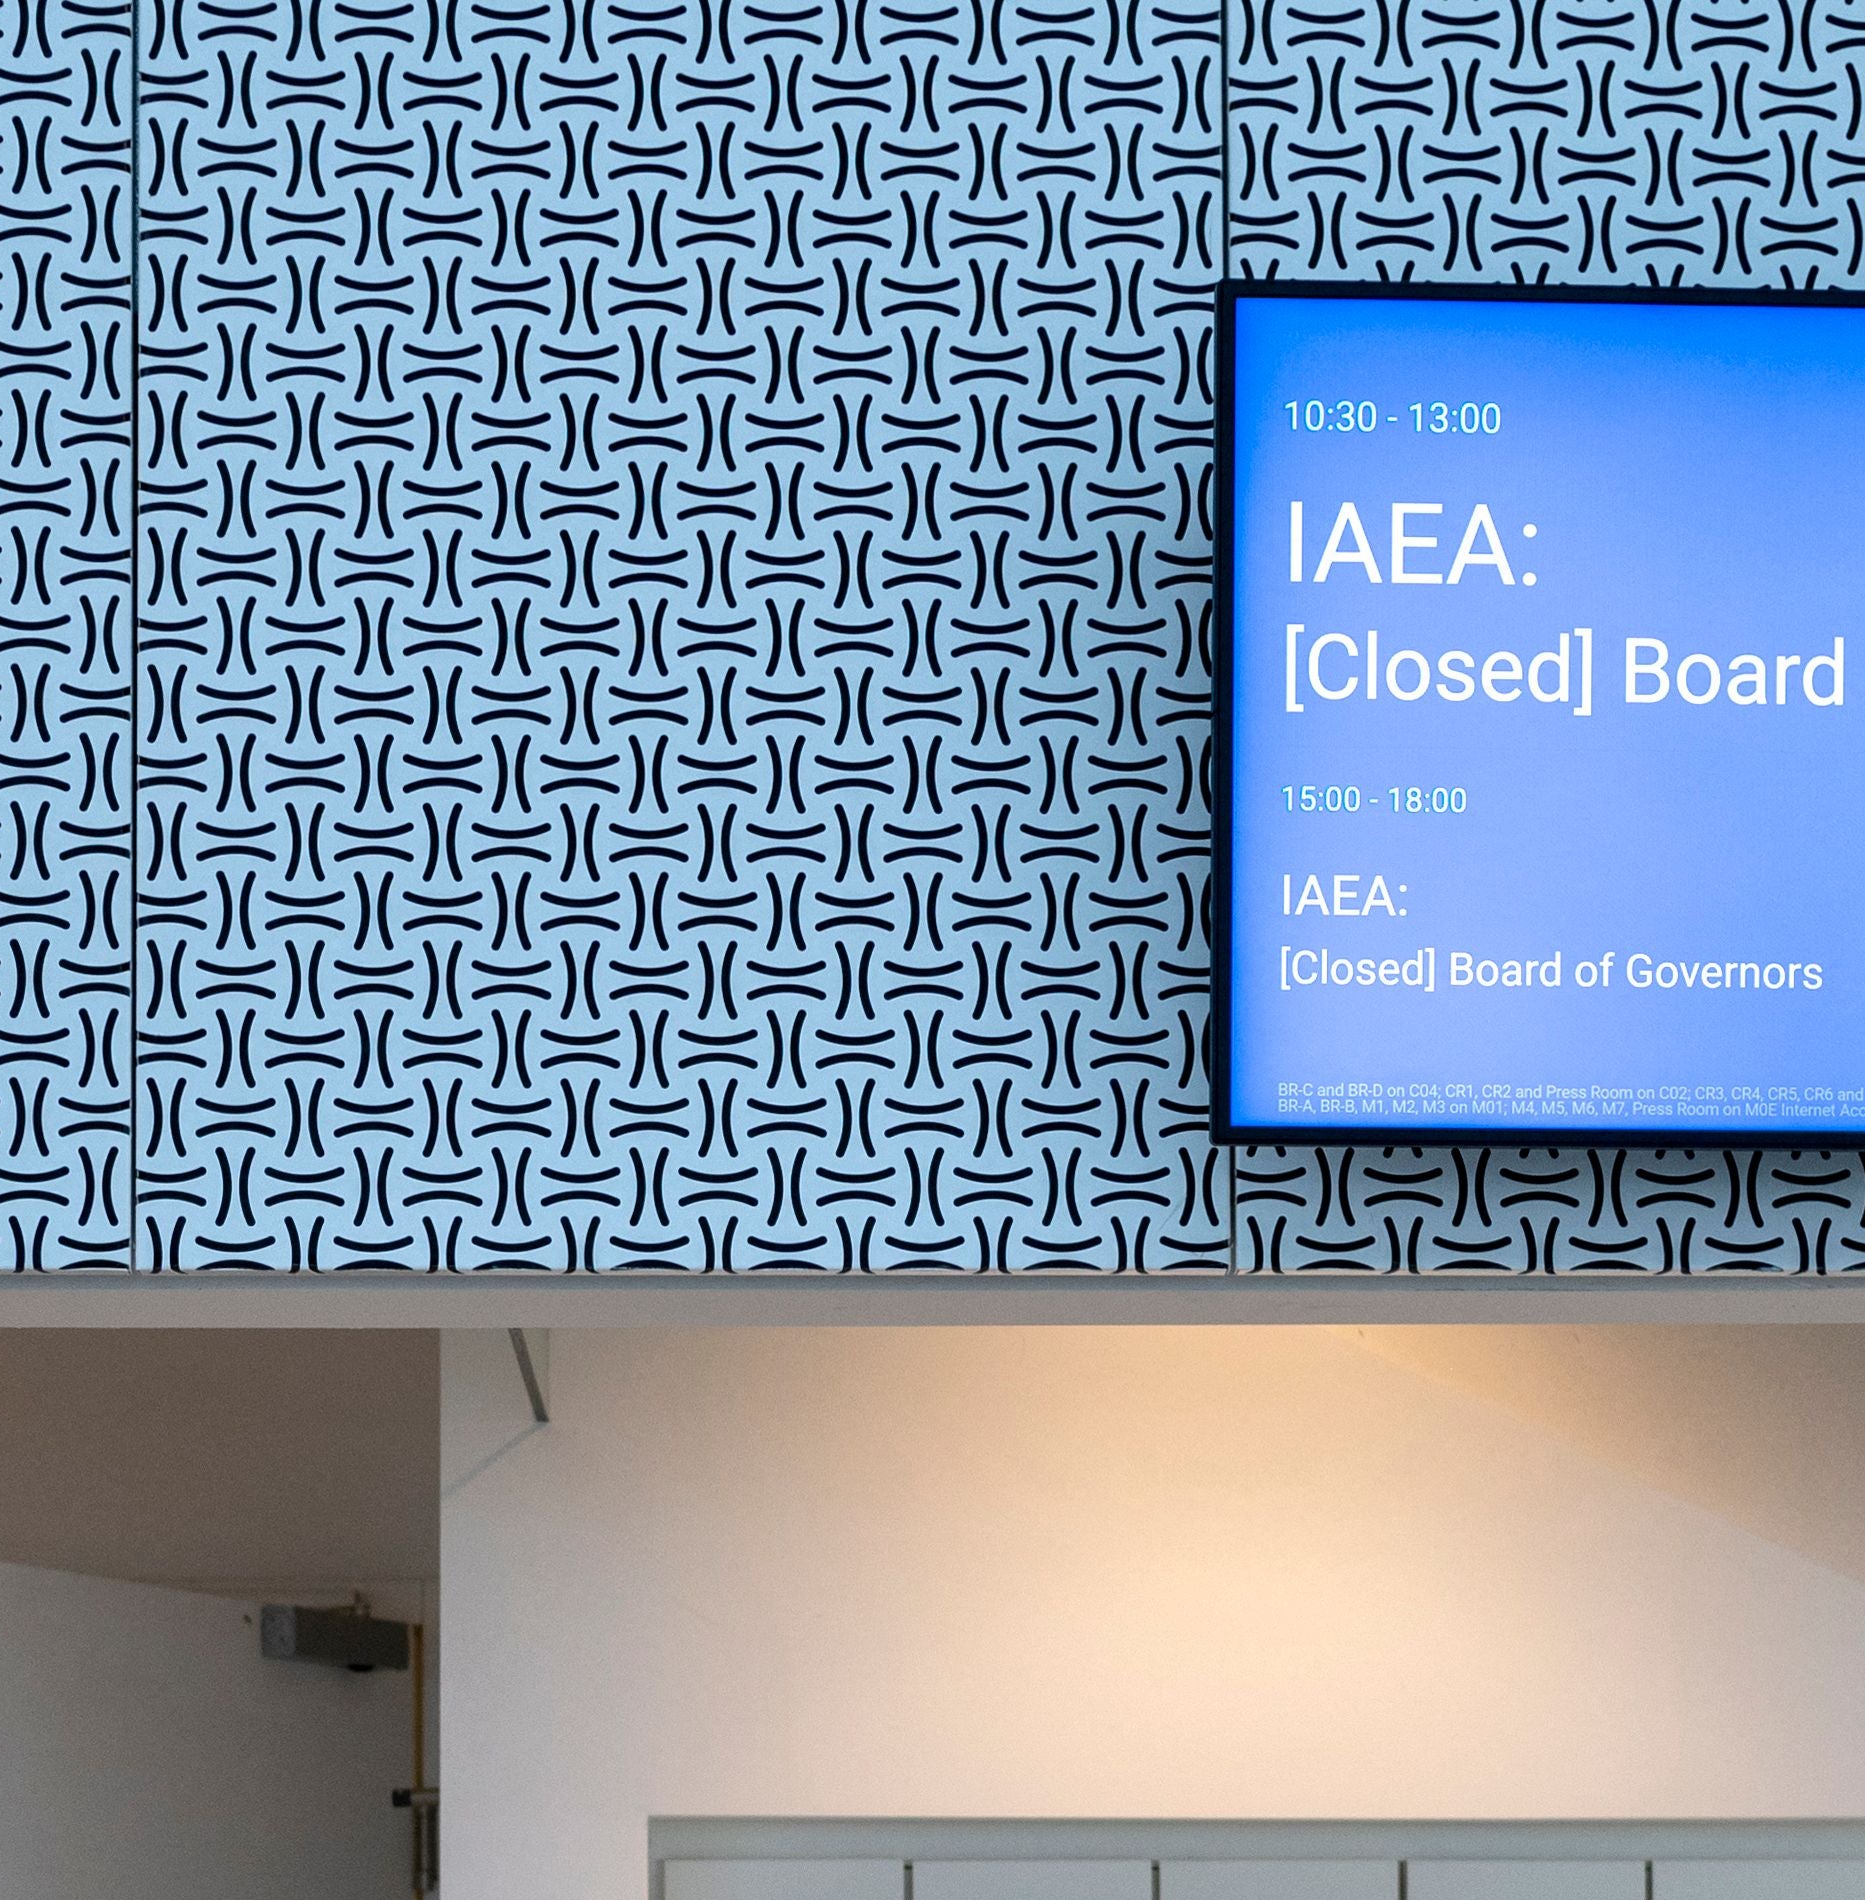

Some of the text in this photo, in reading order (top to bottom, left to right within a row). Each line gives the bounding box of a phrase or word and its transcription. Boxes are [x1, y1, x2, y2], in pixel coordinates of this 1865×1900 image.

[1286, 401, 1376, 431] 10:30
[1410, 403, 1500, 433] 13:00
[1291, 502, 1537, 586] IAEA:
[1286, 624, 1592, 716] [Closed]
[1626, 637, 1844, 706] Board
[1283, 786, 1360, 811] 15:00
[1389, 787, 1466, 812] 18:00
[1284, 875, 1407, 916] IAEA:
[1281, 946, 1822, 992] [Closed] Board of Governors
[1278, 1083, 1313, 1097] BR-C
[1317, 1083, 1344, 1097] and
[1348, 1083, 1383, 1097] BR-D
[1387, 1086, 1405, 1097] on
[1409, 1084, 1441, 1099] C04;
[1445, 1084, 1478, 1099] CR1,
[1482, 1084, 1511, 1098] CR2
[1516, 1085, 1542, 1098] and
[1546, 1085, 1586, 1099] Press
[1591, 1086, 1633, 1099] Room
[1637, 1089, 1655, 1099] on
[1659, 1086, 1691, 1101] C02;
[1695, 1087, 1728, 1101] CR3,
[1731, 1087, 1764, 1101] CR4,
[1768, 1087, 1800, 1102] CR5,
[1804, 1087, 1833, 1101] CR6
[1838, 1088, 1864, 1101] and
[1278, 1099, 1316, 1114] BR-A,
[1321, 1100, 1358, 1115] BR-B,
[1363, 1100, 1388, 1115] M1,
[1393, 1100, 1418, 1115] M2,
[1423, 1100, 1445, 1113] M3
[1450, 1103, 1467, 1113] on
[1472, 1101, 1507, 1116] M01;
[1512, 1101, 1537, 1116] M4,
[1542, 1102, 1567, 1116] M5,
[1572, 1102, 1598, 1116] M6,
[1603, 1102, 1628, 1117] M7,
[1633, 1102, 1673, 1115] Press
[1677, 1103, 1719, 1116] Room
[1723, 1106, 1741, 1116] on
[1781, 1104, 1835, 1117] Internet
